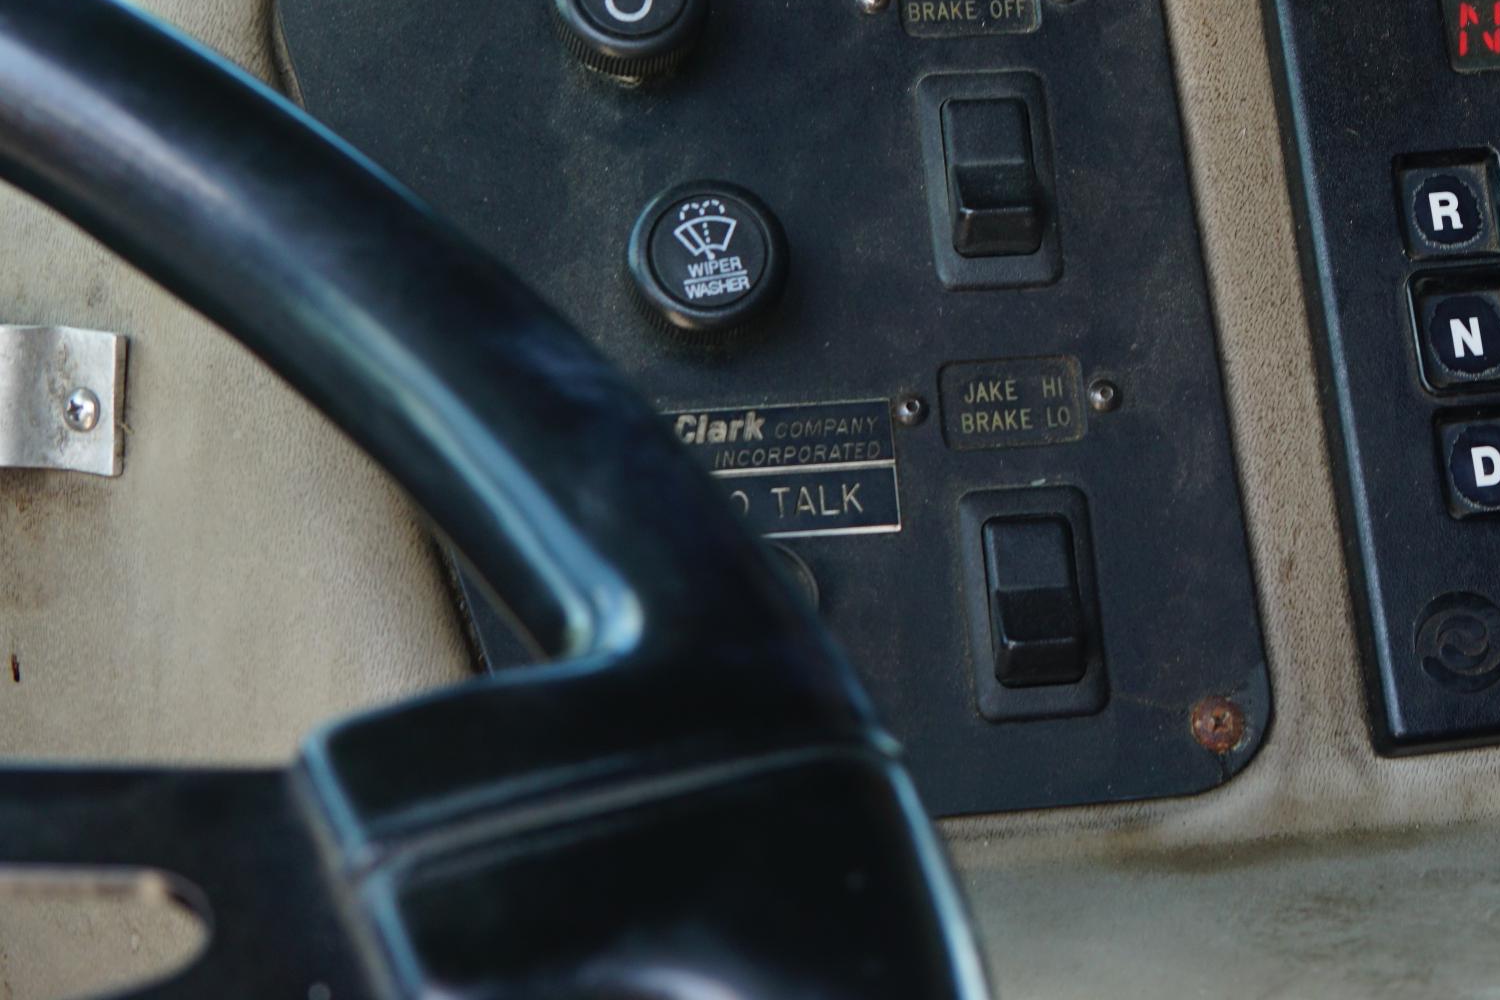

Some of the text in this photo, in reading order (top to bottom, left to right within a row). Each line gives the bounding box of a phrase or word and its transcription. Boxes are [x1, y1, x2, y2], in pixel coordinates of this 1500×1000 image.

[908, 0, 979, 22] BRAKE
[1428, 191, 1463, 231] R
[687, 256, 743, 278] WIPER
[684, 276, 751, 300] WASHER
[1449, 316, 1484, 358] N
[964, 376, 1063, 404] JAKE HI
[674, 410, 878, 444] Clark COMPANY
[961, 405, 1071, 434] BRAKE LO
[714, 441, 881, 468] INCORPORATED
[770, 482, 864, 518] TALK
